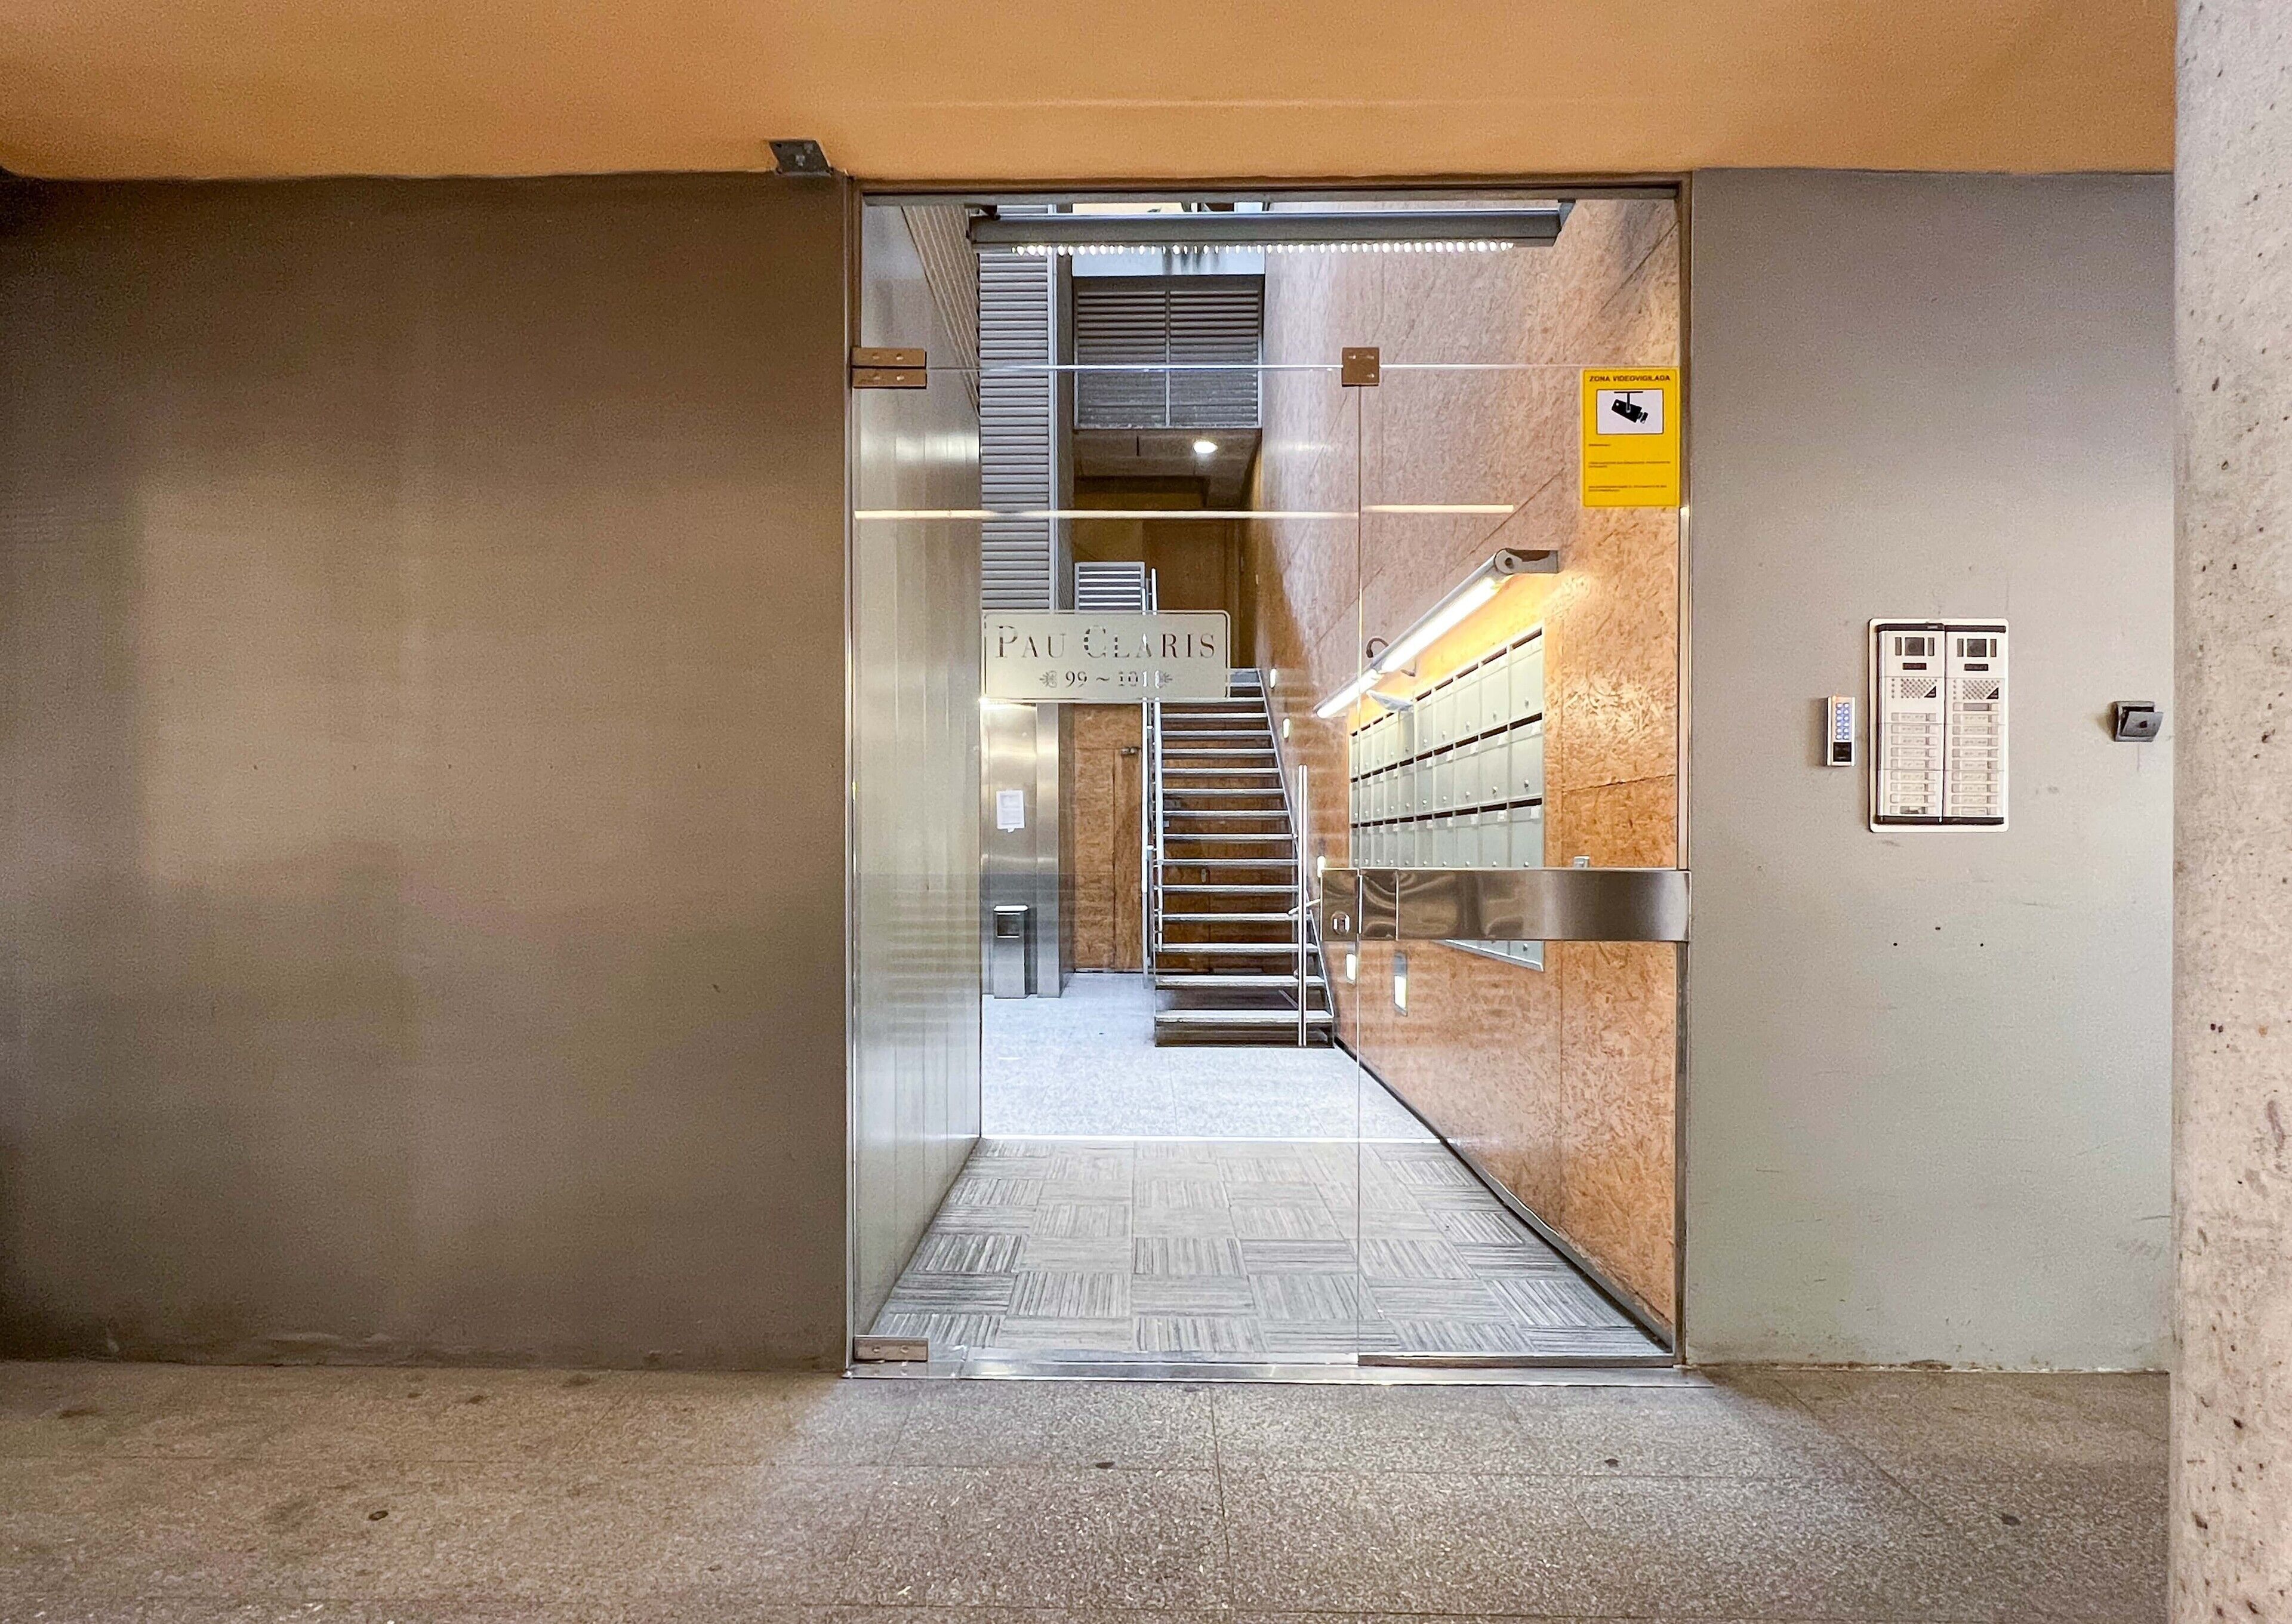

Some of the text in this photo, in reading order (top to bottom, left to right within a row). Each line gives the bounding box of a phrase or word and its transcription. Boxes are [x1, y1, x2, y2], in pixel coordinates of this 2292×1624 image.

[996, 625, 1215, 658] PAU CLARIS
[1065, 670, 1088, 688] 99
